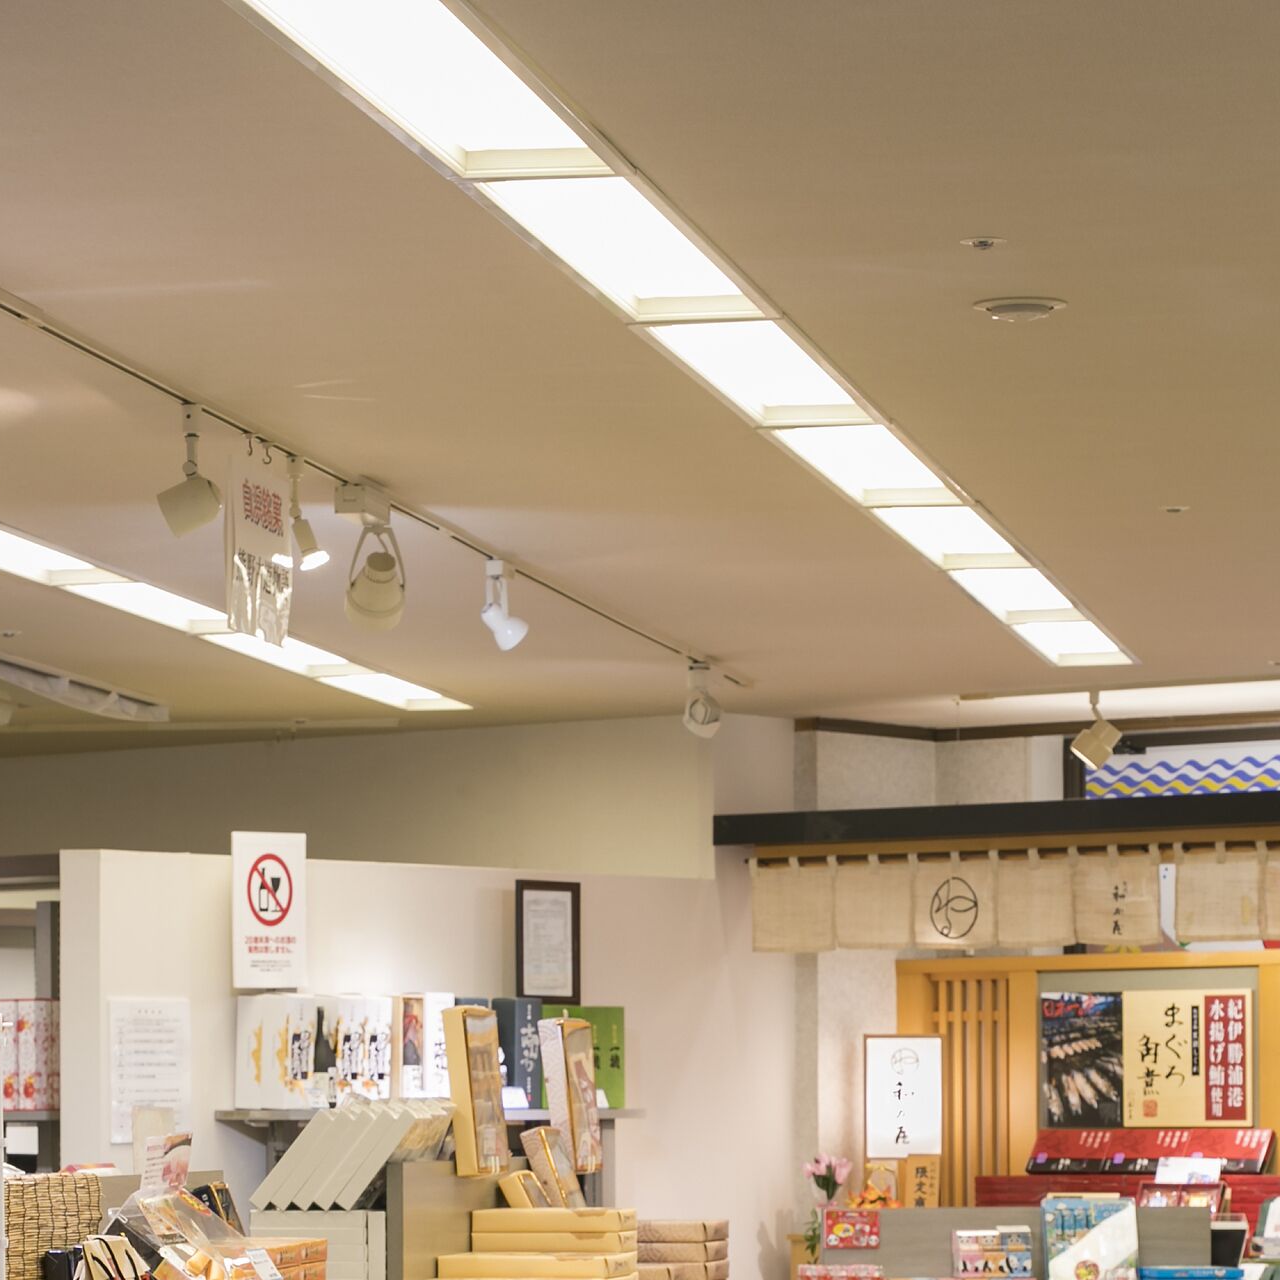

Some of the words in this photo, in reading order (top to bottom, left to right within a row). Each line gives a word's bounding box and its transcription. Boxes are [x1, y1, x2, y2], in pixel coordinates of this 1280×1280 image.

[1164, 1003, 1187, 1088] まぐろ
[1227, 999, 1244, 1107] 紀伊勝浦港
